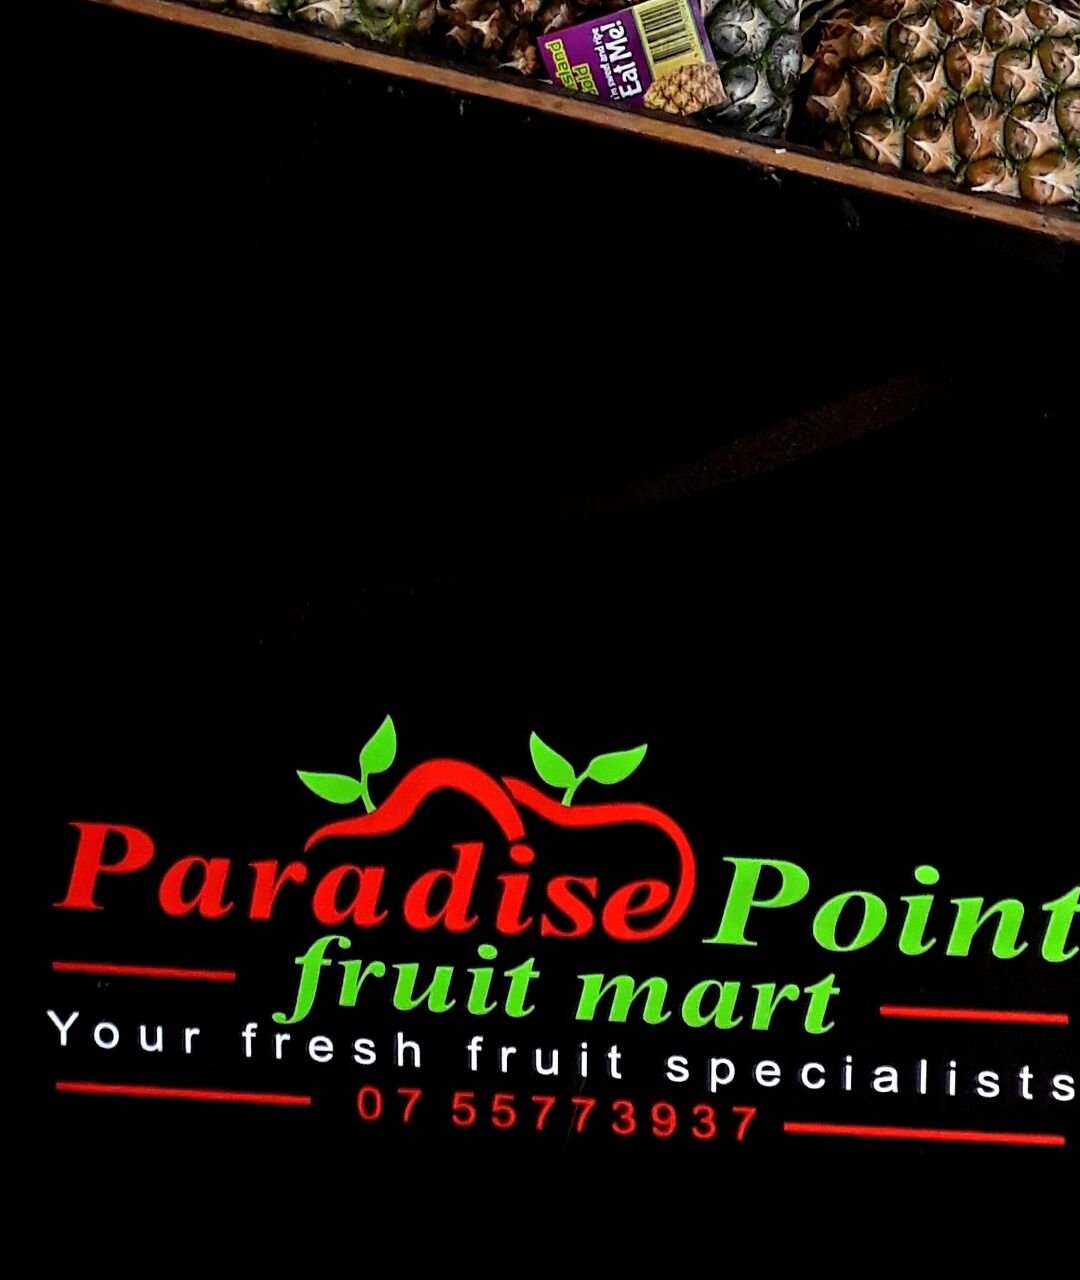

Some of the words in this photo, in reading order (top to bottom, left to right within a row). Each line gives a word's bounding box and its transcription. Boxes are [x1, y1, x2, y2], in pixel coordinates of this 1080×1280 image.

[545, 39, 578, 91] sland
[600, 20, 633, 63] Me!
[571, 63, 600, 96] old
[612, 61, 642, 99] Eat
[52, 820, 697, 942] Paradise
[272, 934, 541, 1025] fruit
[575, 973, 841, 1035] mart
[46, 1008, 200, 1054] Your
[240, 1021, 422, 1068] fresh
[466, 1035, 623, 1081] fruit
[665, 1054, 1077, 1103] specialists
[356, 1084, 423, 1123] 07
[451, 1090, 758, 1143] 55773937
